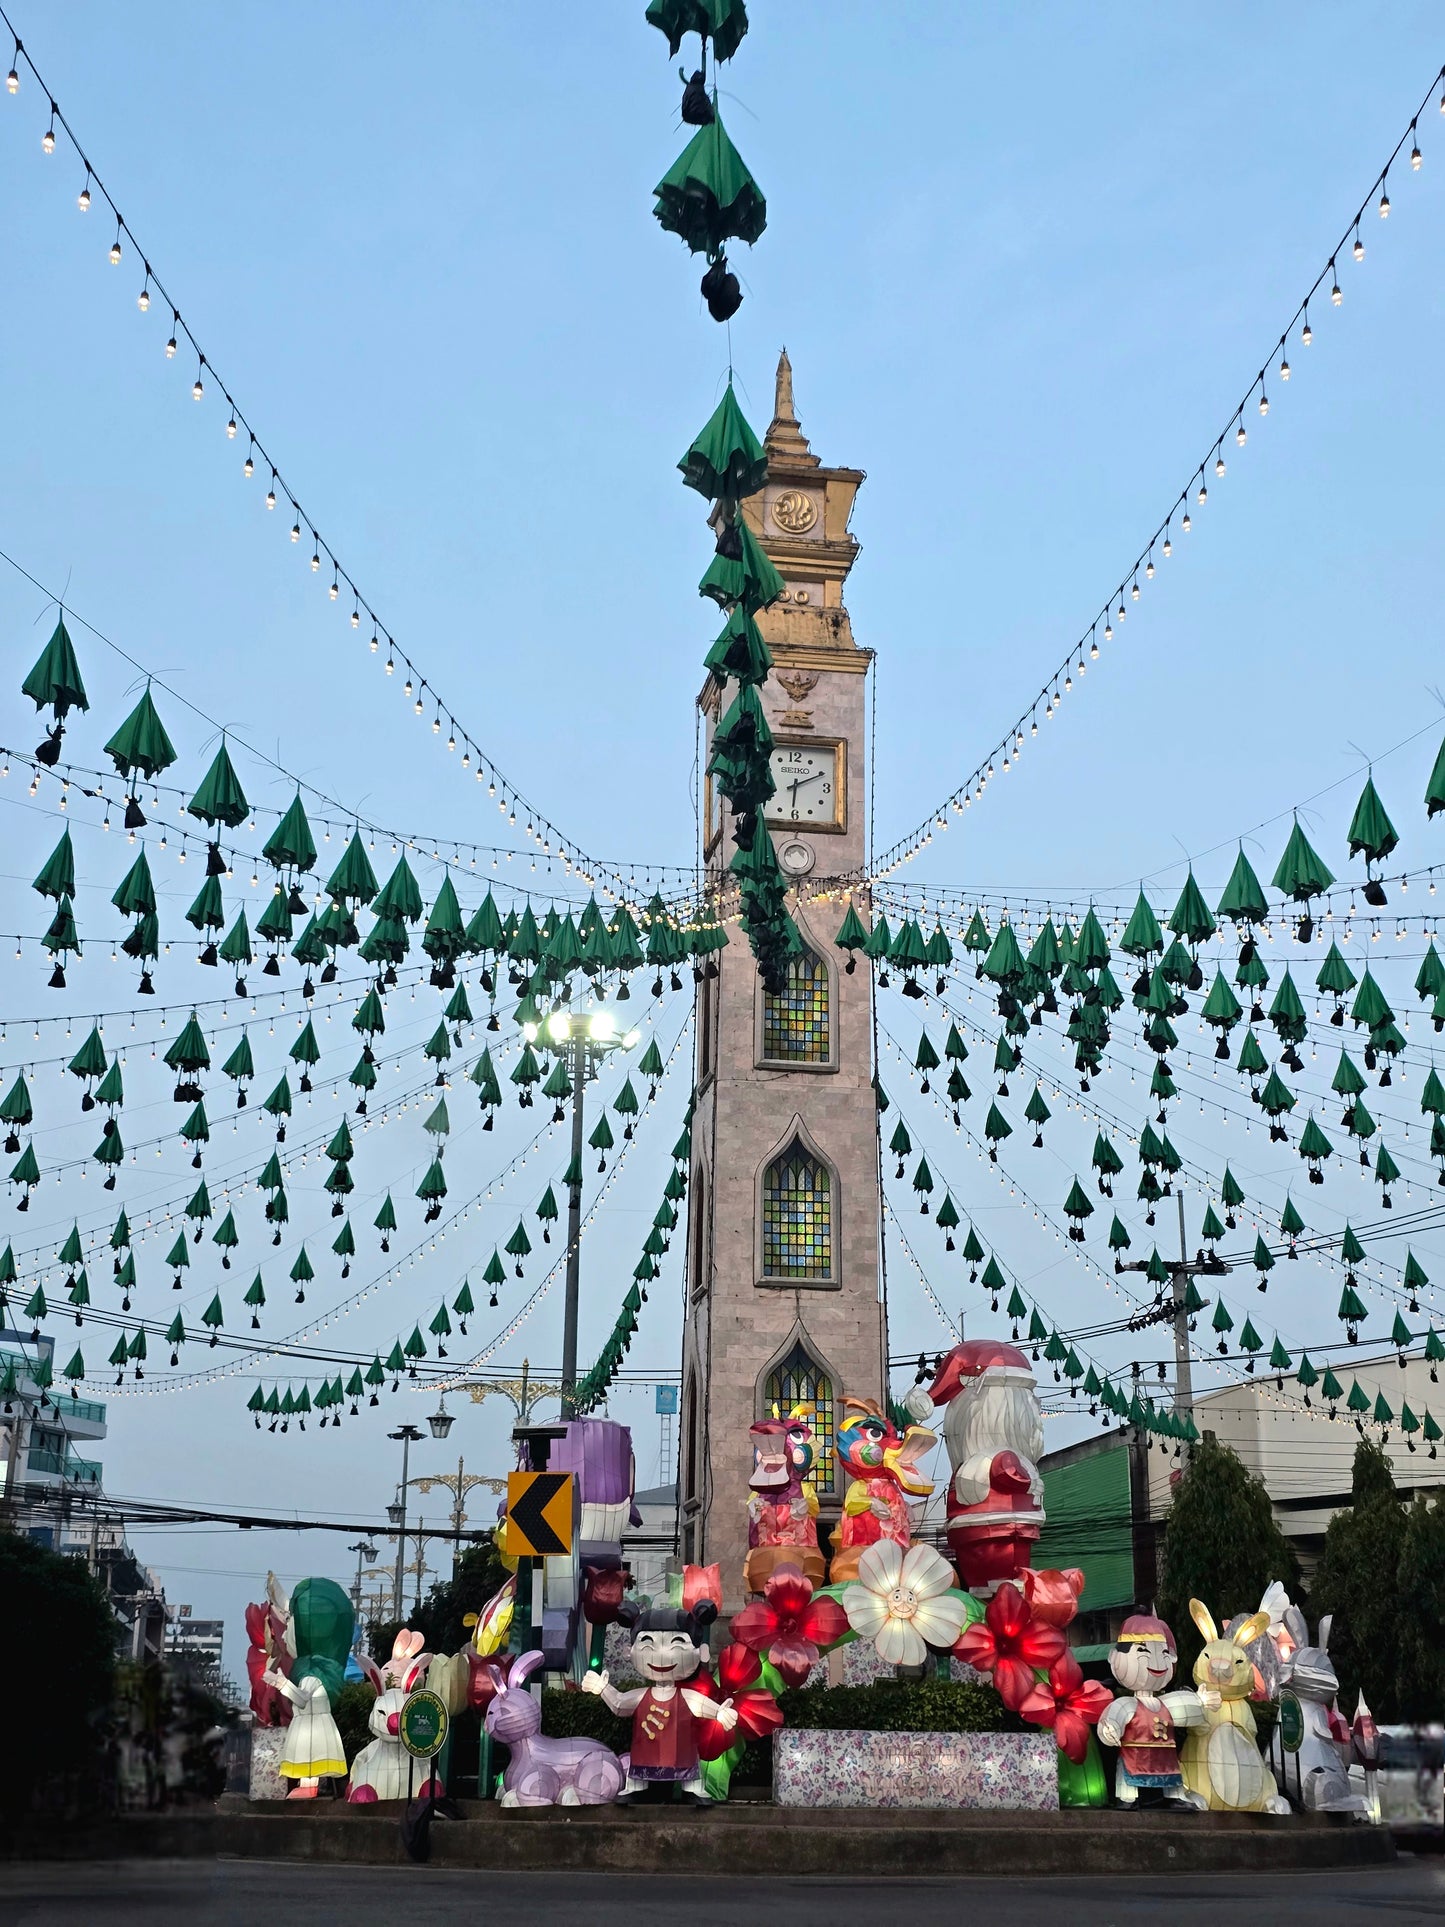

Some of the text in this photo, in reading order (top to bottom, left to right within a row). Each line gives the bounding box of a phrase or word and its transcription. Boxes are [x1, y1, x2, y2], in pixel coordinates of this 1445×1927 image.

[788, 751, 802, 763] 12
[780, 766, 810, 775] SEIKO
[822, 782, 831, 794] 3
[790, 809, 799, 821] 6
